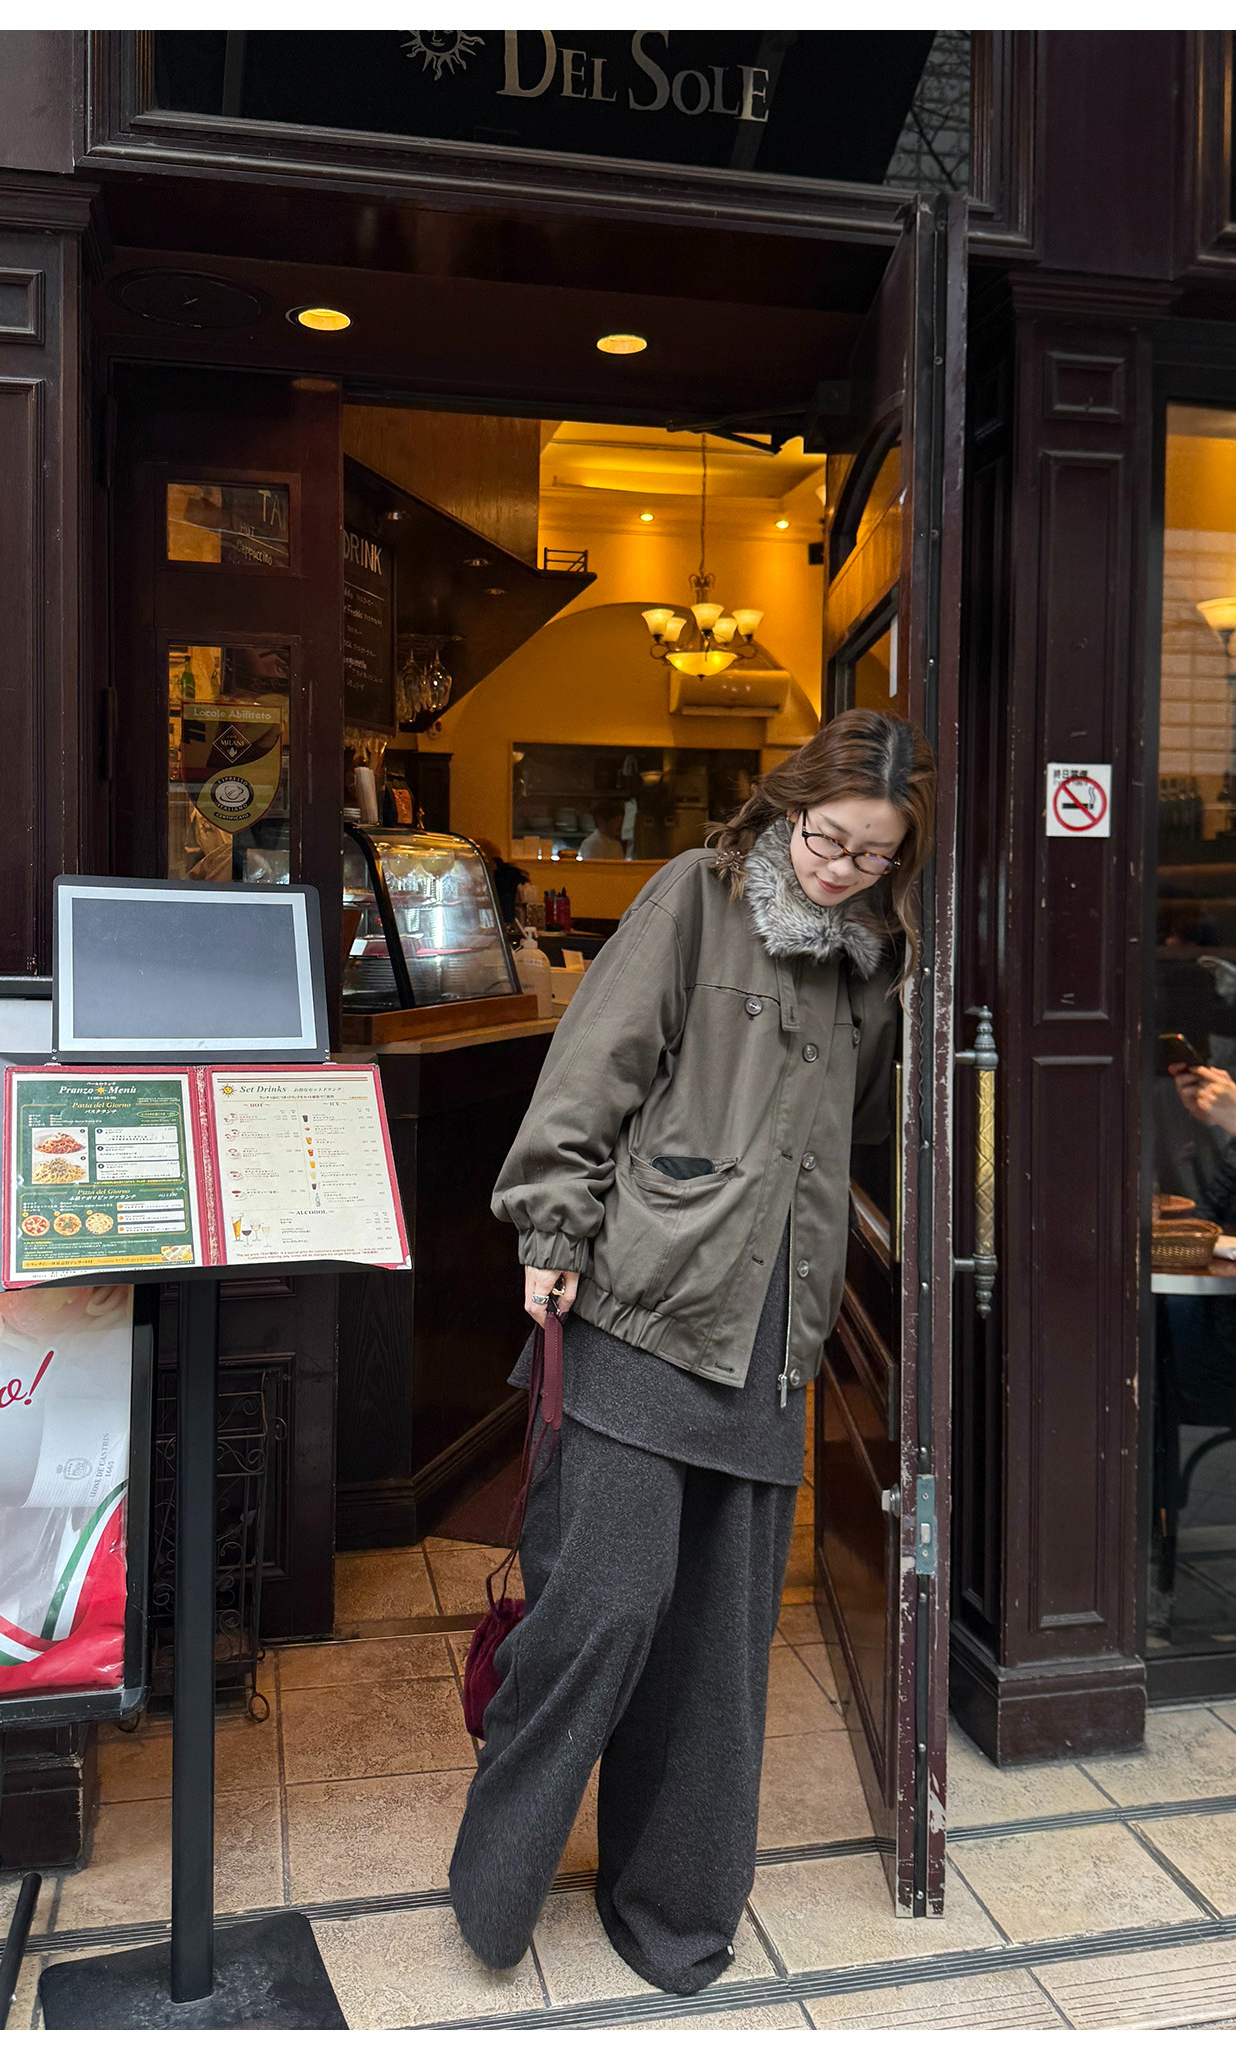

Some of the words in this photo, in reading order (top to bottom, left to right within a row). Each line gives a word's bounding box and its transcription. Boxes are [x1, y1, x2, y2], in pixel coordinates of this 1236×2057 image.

[628, 30, 770, 123] SOLE
[343, 529, 382, 576] DRINK
[193, 707, 226, 718] Locale
[228, 710, 272, 720] Abilitato
[217, 803, 249, 812] ITALIANO
[59, 1086, 94, 1094] Pranzo
[107, 1085, 137, 1094] Menù
[239, 1085, 254, 1093] Set
[256, 1085, 287, 1093] Drinks
[89, 1477, 101, 1499] LEONE
[95, 1462, 105, 1478] DE
